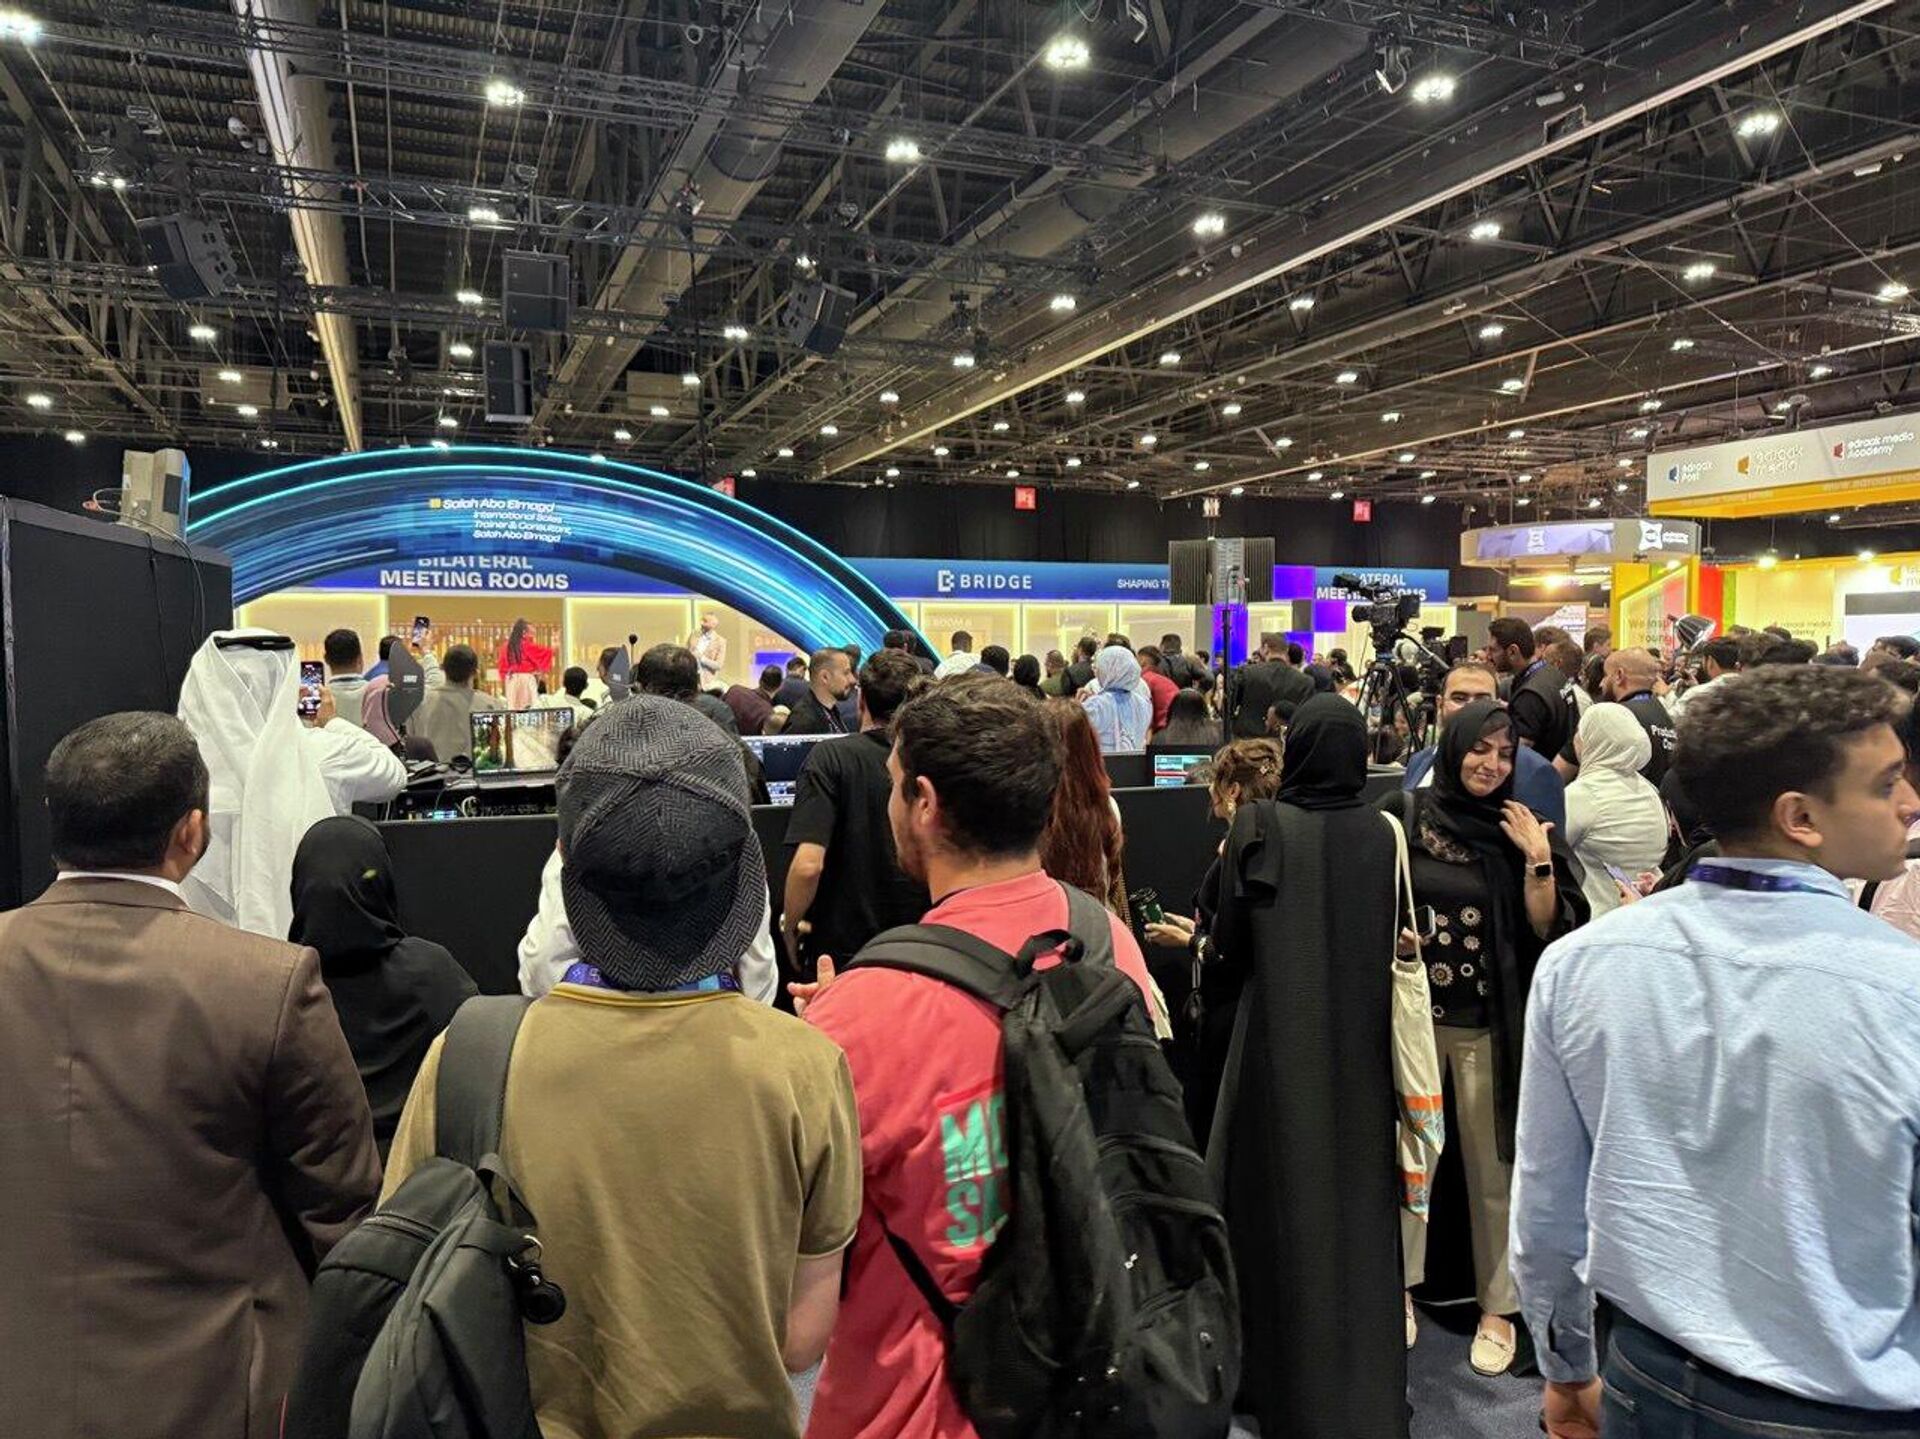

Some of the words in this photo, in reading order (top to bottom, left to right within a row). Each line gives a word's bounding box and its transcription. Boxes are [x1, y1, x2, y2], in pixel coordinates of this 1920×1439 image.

[480, 498, 507, 510] Abo
[379, 570, 484, 588] MEETING
[488, 572, 570, 590] ROOMS
[960, 574, 1032, 590] BRIDGE
[1116, 578, 1159, 590] SHAPING
